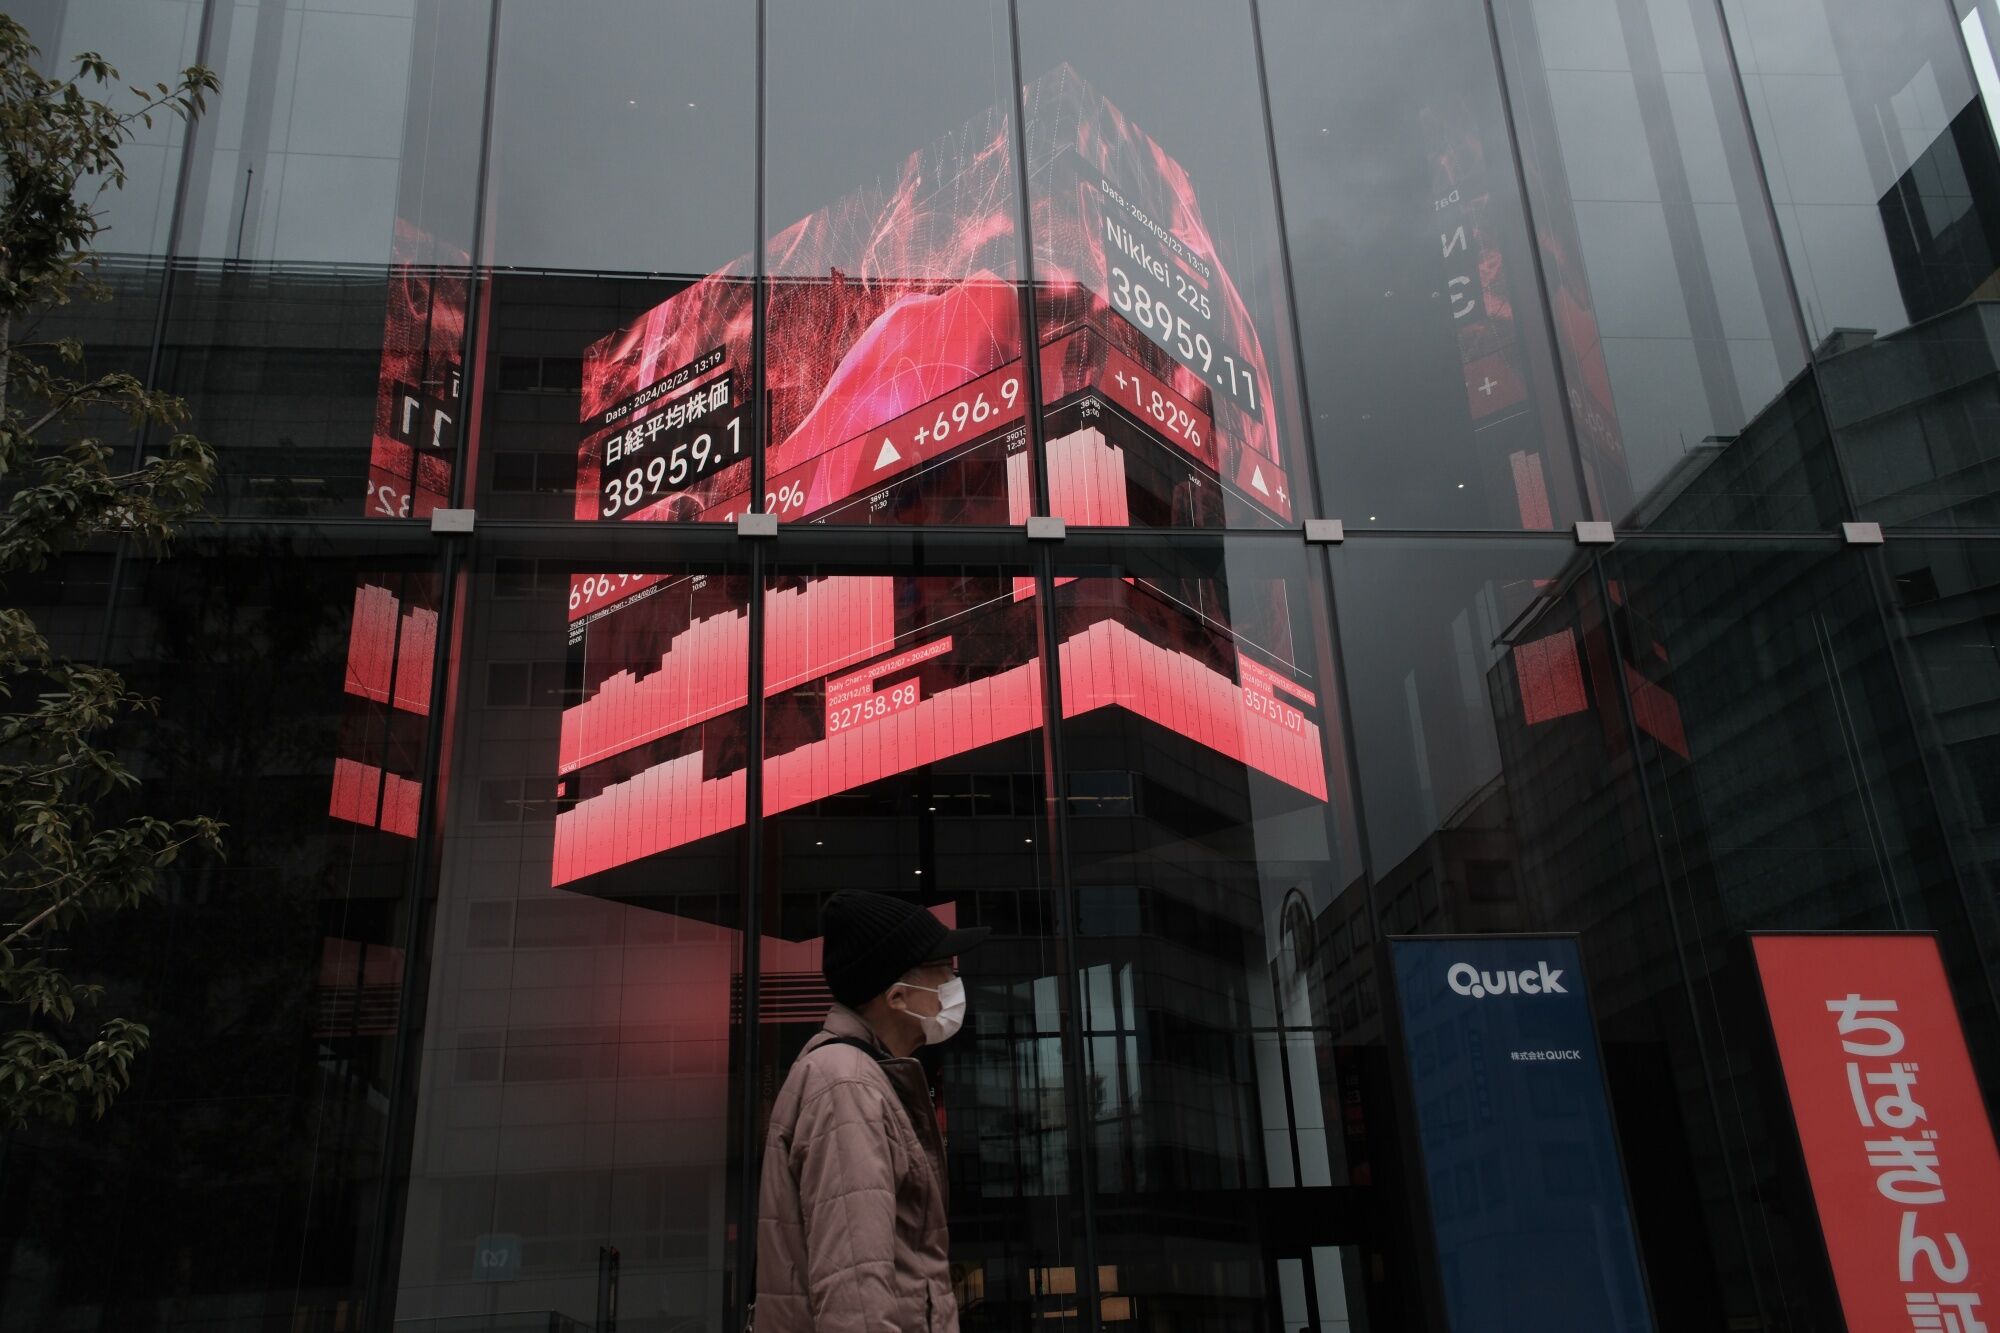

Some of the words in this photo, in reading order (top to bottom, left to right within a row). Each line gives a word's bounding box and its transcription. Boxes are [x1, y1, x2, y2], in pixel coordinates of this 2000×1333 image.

[1131, 204, 1183, 256] 2024/02/22
[1106, 216, 1170, 288] Nikkei
[1176, 275, 1211, 320] 225
[1112, 267, 1256, 410] 38959.11
[605, 403, 627, 424] Data
[634, 369, 689, 409] 2024/02/22
[694, 351, 721, 375] 13:19
[914, 378, 1019, 445] +696.9
[1114, 370, 1201, 448] +1.82%
[606, 377, 730, 467] 日経平均株価
[828, 684, 871, 707] 2023/12/18
[829, 684, 915, 732] 32758.98
[1244, 687, 1301, 732] 35751.07
[1510, 1049, 1582, 1061] 株式会社QUICK
